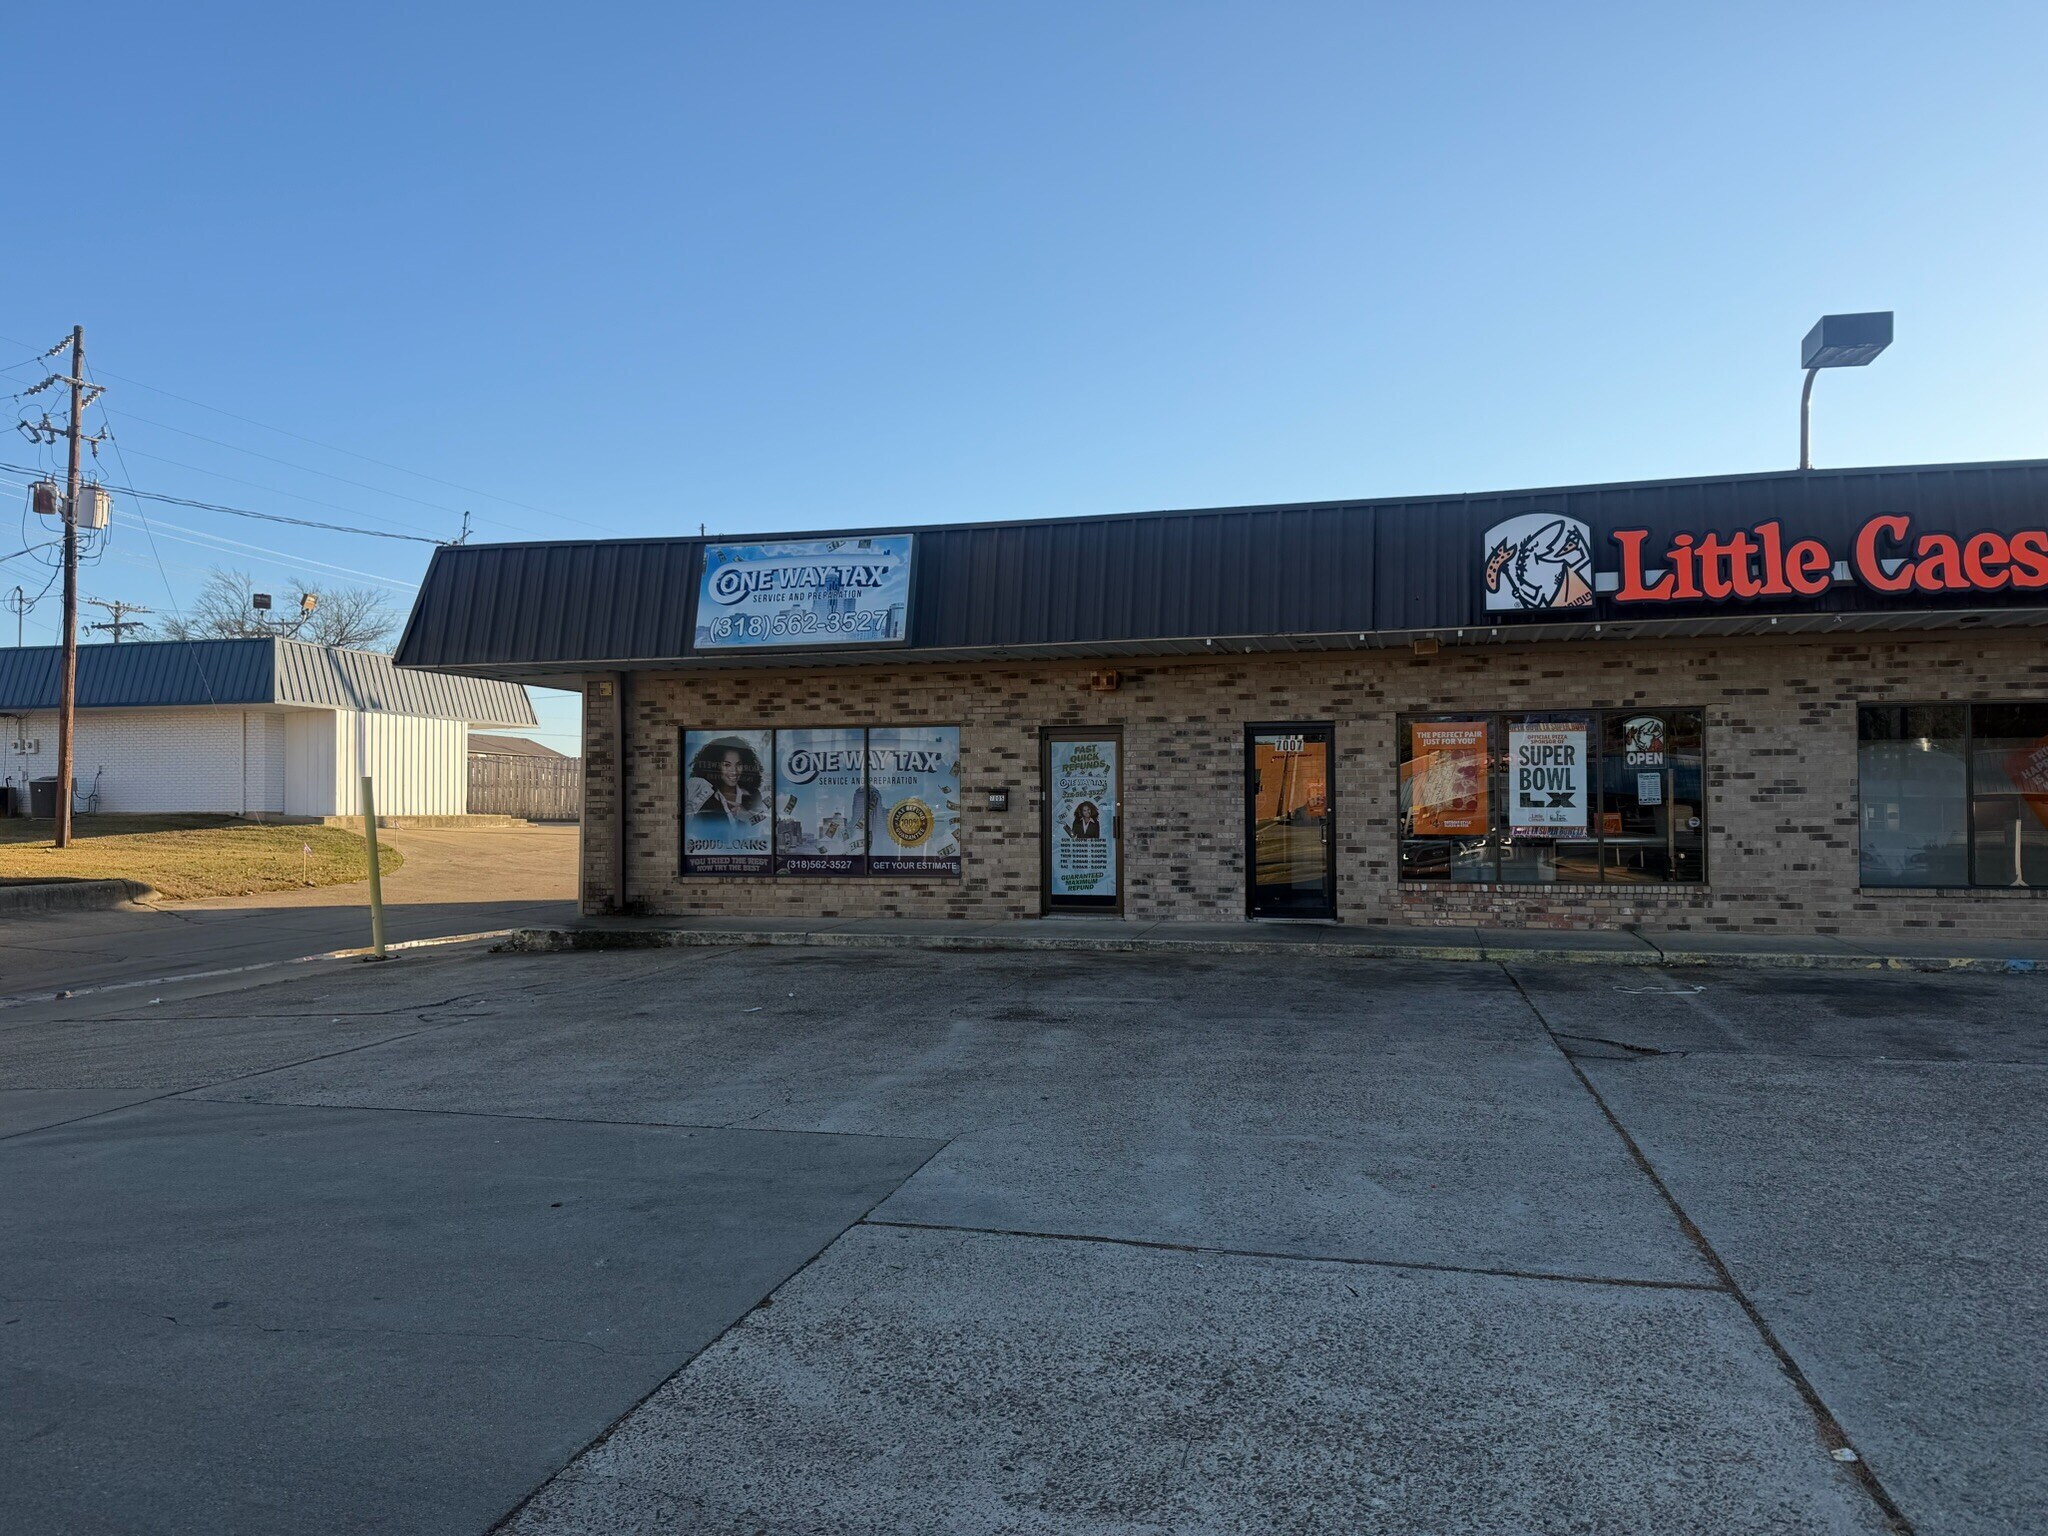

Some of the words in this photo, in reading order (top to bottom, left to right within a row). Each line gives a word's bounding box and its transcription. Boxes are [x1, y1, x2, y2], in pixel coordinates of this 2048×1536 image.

[1613, 521, 1830, 601] Little
[1856, 515, 2048, 591] Caes
[716, 568, 773, 598] ONE
[778, 566, 829, 590] WAY
[831, 565, 888, 588] TAX
[753, 593, 786, 603] SERVICE
[789, 592, 804, 602] AND
[807, 589, 862, 600] PREPARATION
[710, 610, 889, 643] (318)562-3527
[1276, 740, 1302, 751] 7007
[1423, 738, 1440, 746] JUST
[1074, 744, 1097, 754] FAST
[1070, 753, 1099, 763] QUICK
[1519, 745, 1575, 766] SUPER
[1627, 752, 1663, 765] OPEN
[787, 749, 840, 777] ONE
[842, 750, 887, 771] WAY
[893, 750, 941, 773] TAX
[1062, 760, 1106, 772] REFUNDS
[819, 776, 848, 785] SERVICE
[851, 776, 866, 785] AND
[869, 776, 918, 785] PREPARATION
[1519, 768, 1576, 791] BOWL
[2032, 774, 2044, 785] IS
[1519, 792, 1576, 808] LX
[894, 807, 905, 820] MAX
[906, 806, 926, 820] REFUND
[901, 819, 919, 827] 100%
[896, 828, 925, 840] GUARANTEE
[726, 839, 768, 851] LOANS
[690, 858, 706, 866] YOU
[707, 857, 730, 865] TRIED
[731, 857, 746, 865] THE
[748, 858, 768, 866] REST
[786, 859, 852, 870] (318)562-3527
[873, 861, 890, 870] GET
[892, 861, 915, 870] YOUR
[916, 861, 957, 870] ESTIMATE
[1061, 872, 1104, 881] GUARANTEED
